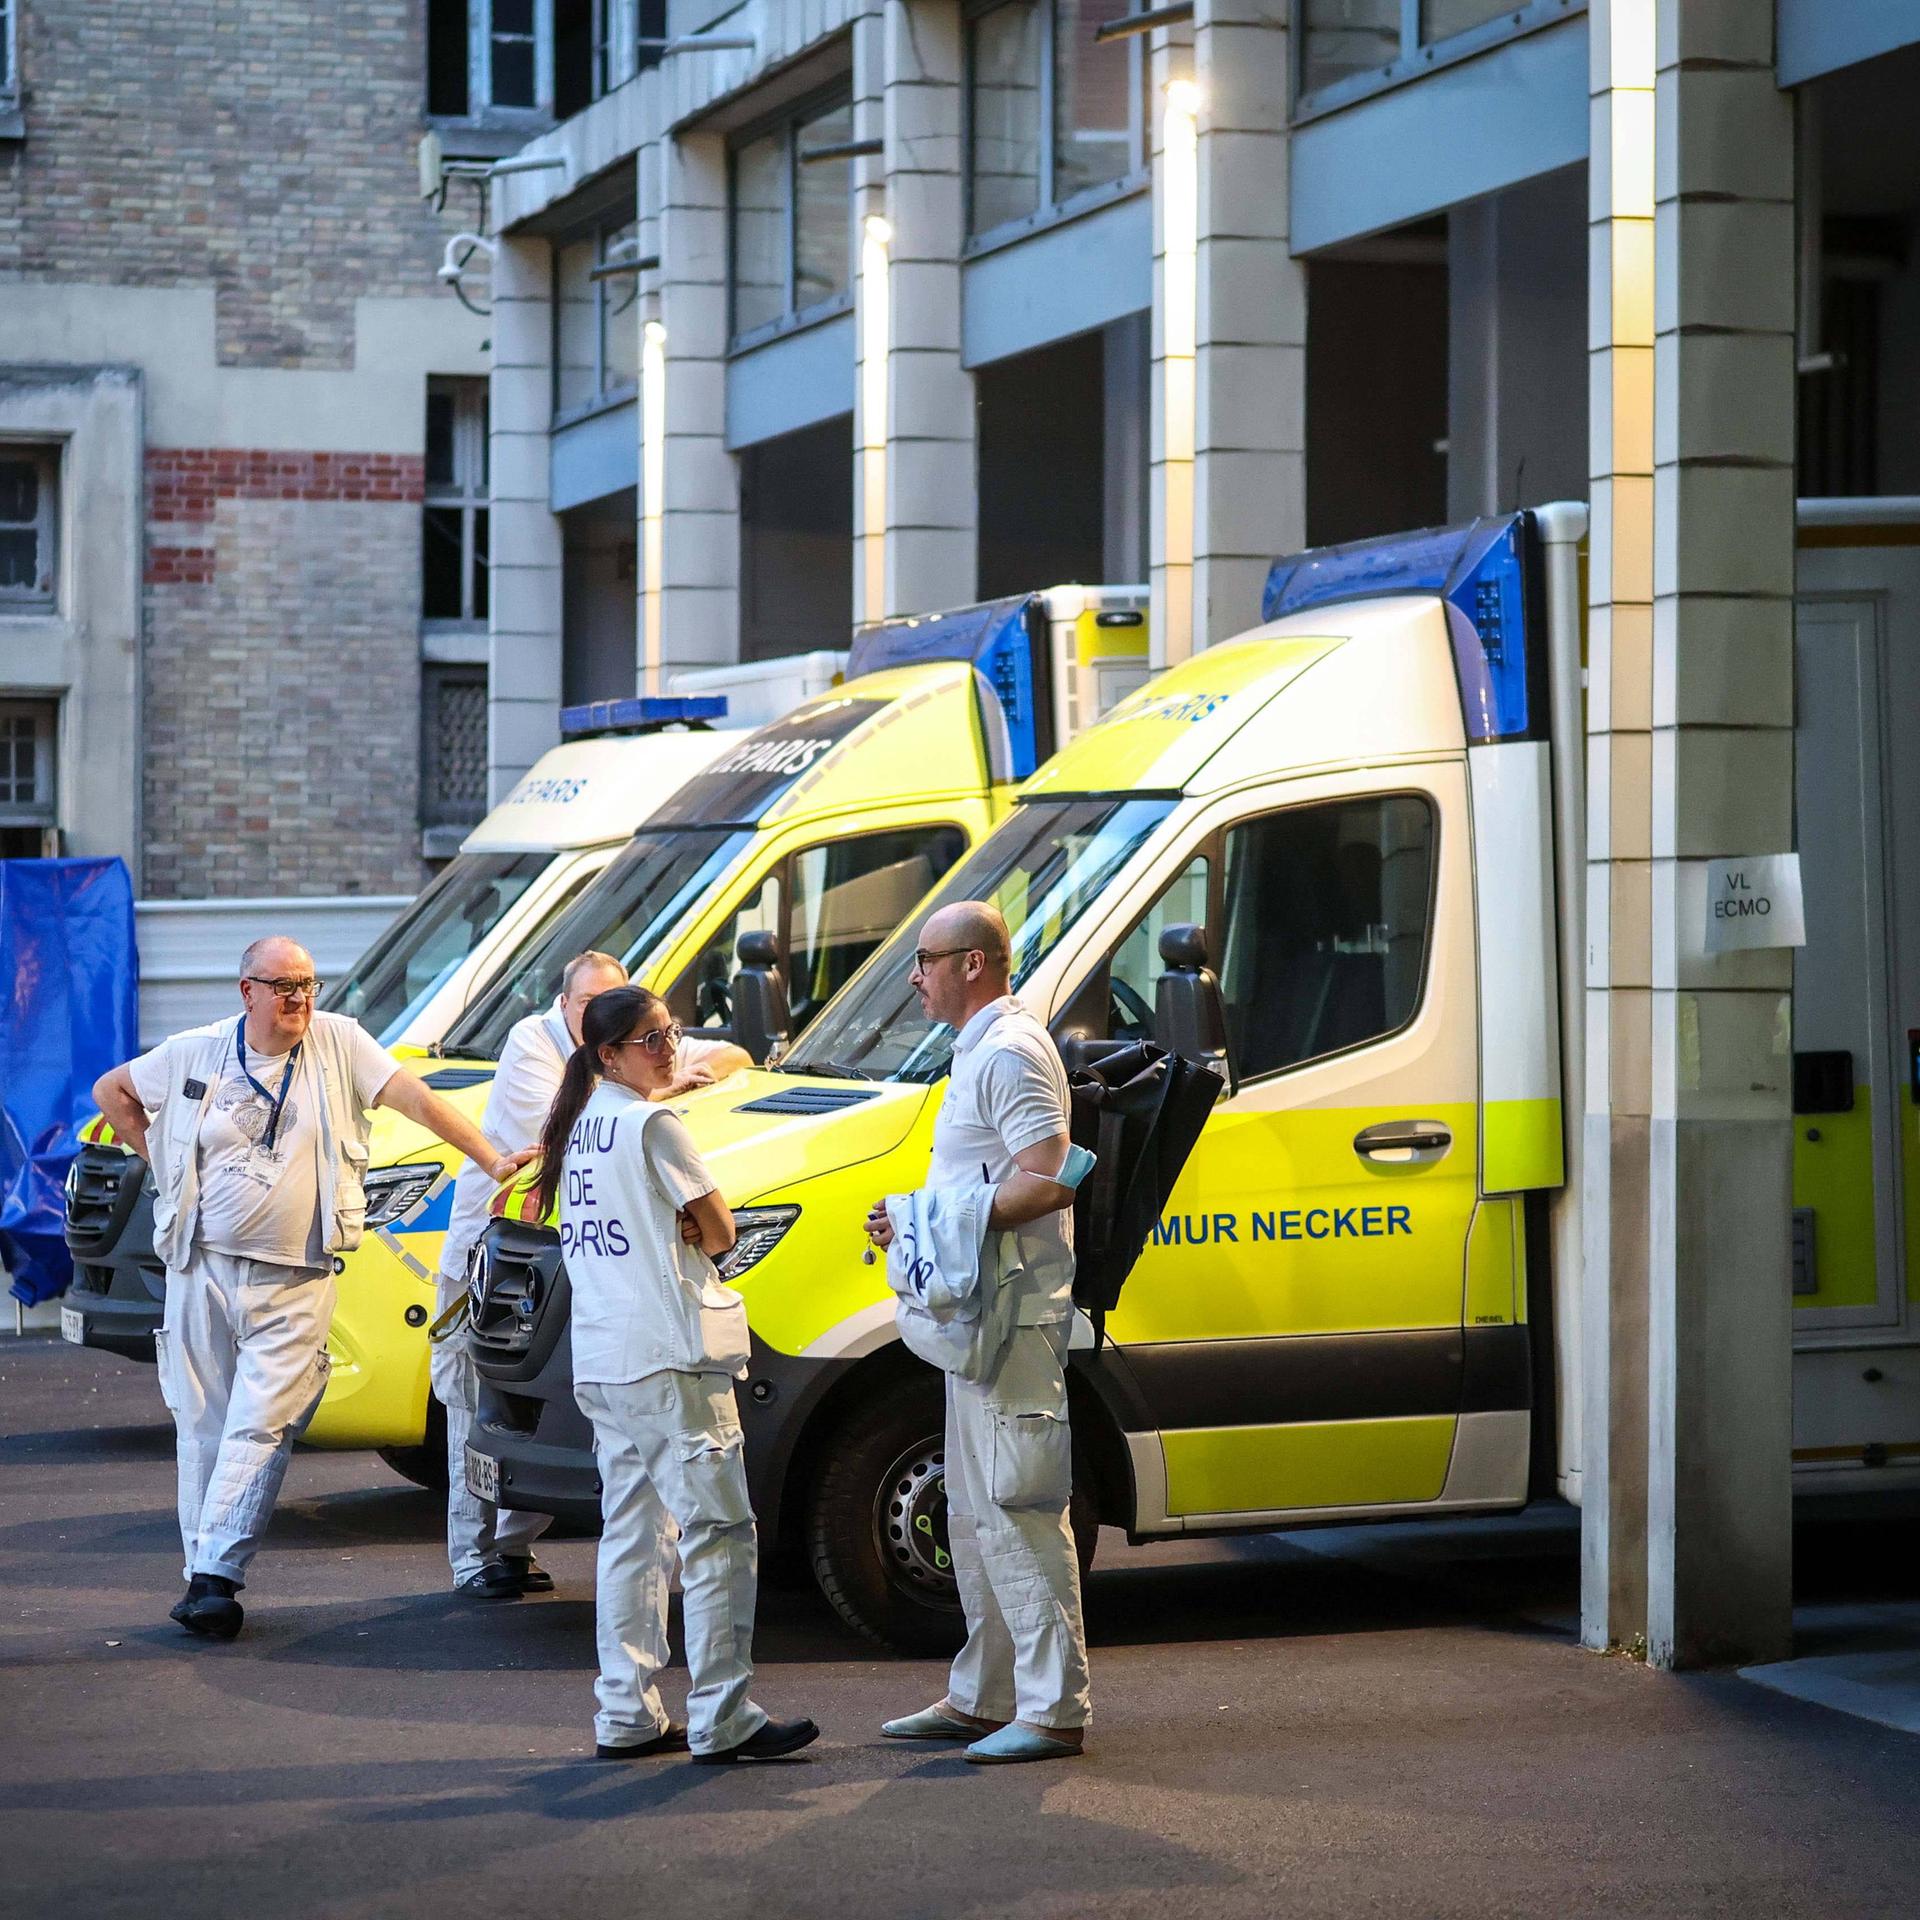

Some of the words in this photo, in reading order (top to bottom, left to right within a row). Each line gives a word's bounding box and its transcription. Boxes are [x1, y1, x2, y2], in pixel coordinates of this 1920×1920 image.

[729, 739, 832, 775] PARIS
[1726, 873, 1751, 890] VL
[1714, 897, 1771, 918] ECMO
[564, 1116, 618, 1156] AMU
[569, 1168, 597, 1207] DE
[560, 1218, 630, 1259] PARIS
[1152, 1213, 1239, 1246] MUR
[1252, 1205, 1413, 1241] NECKER
